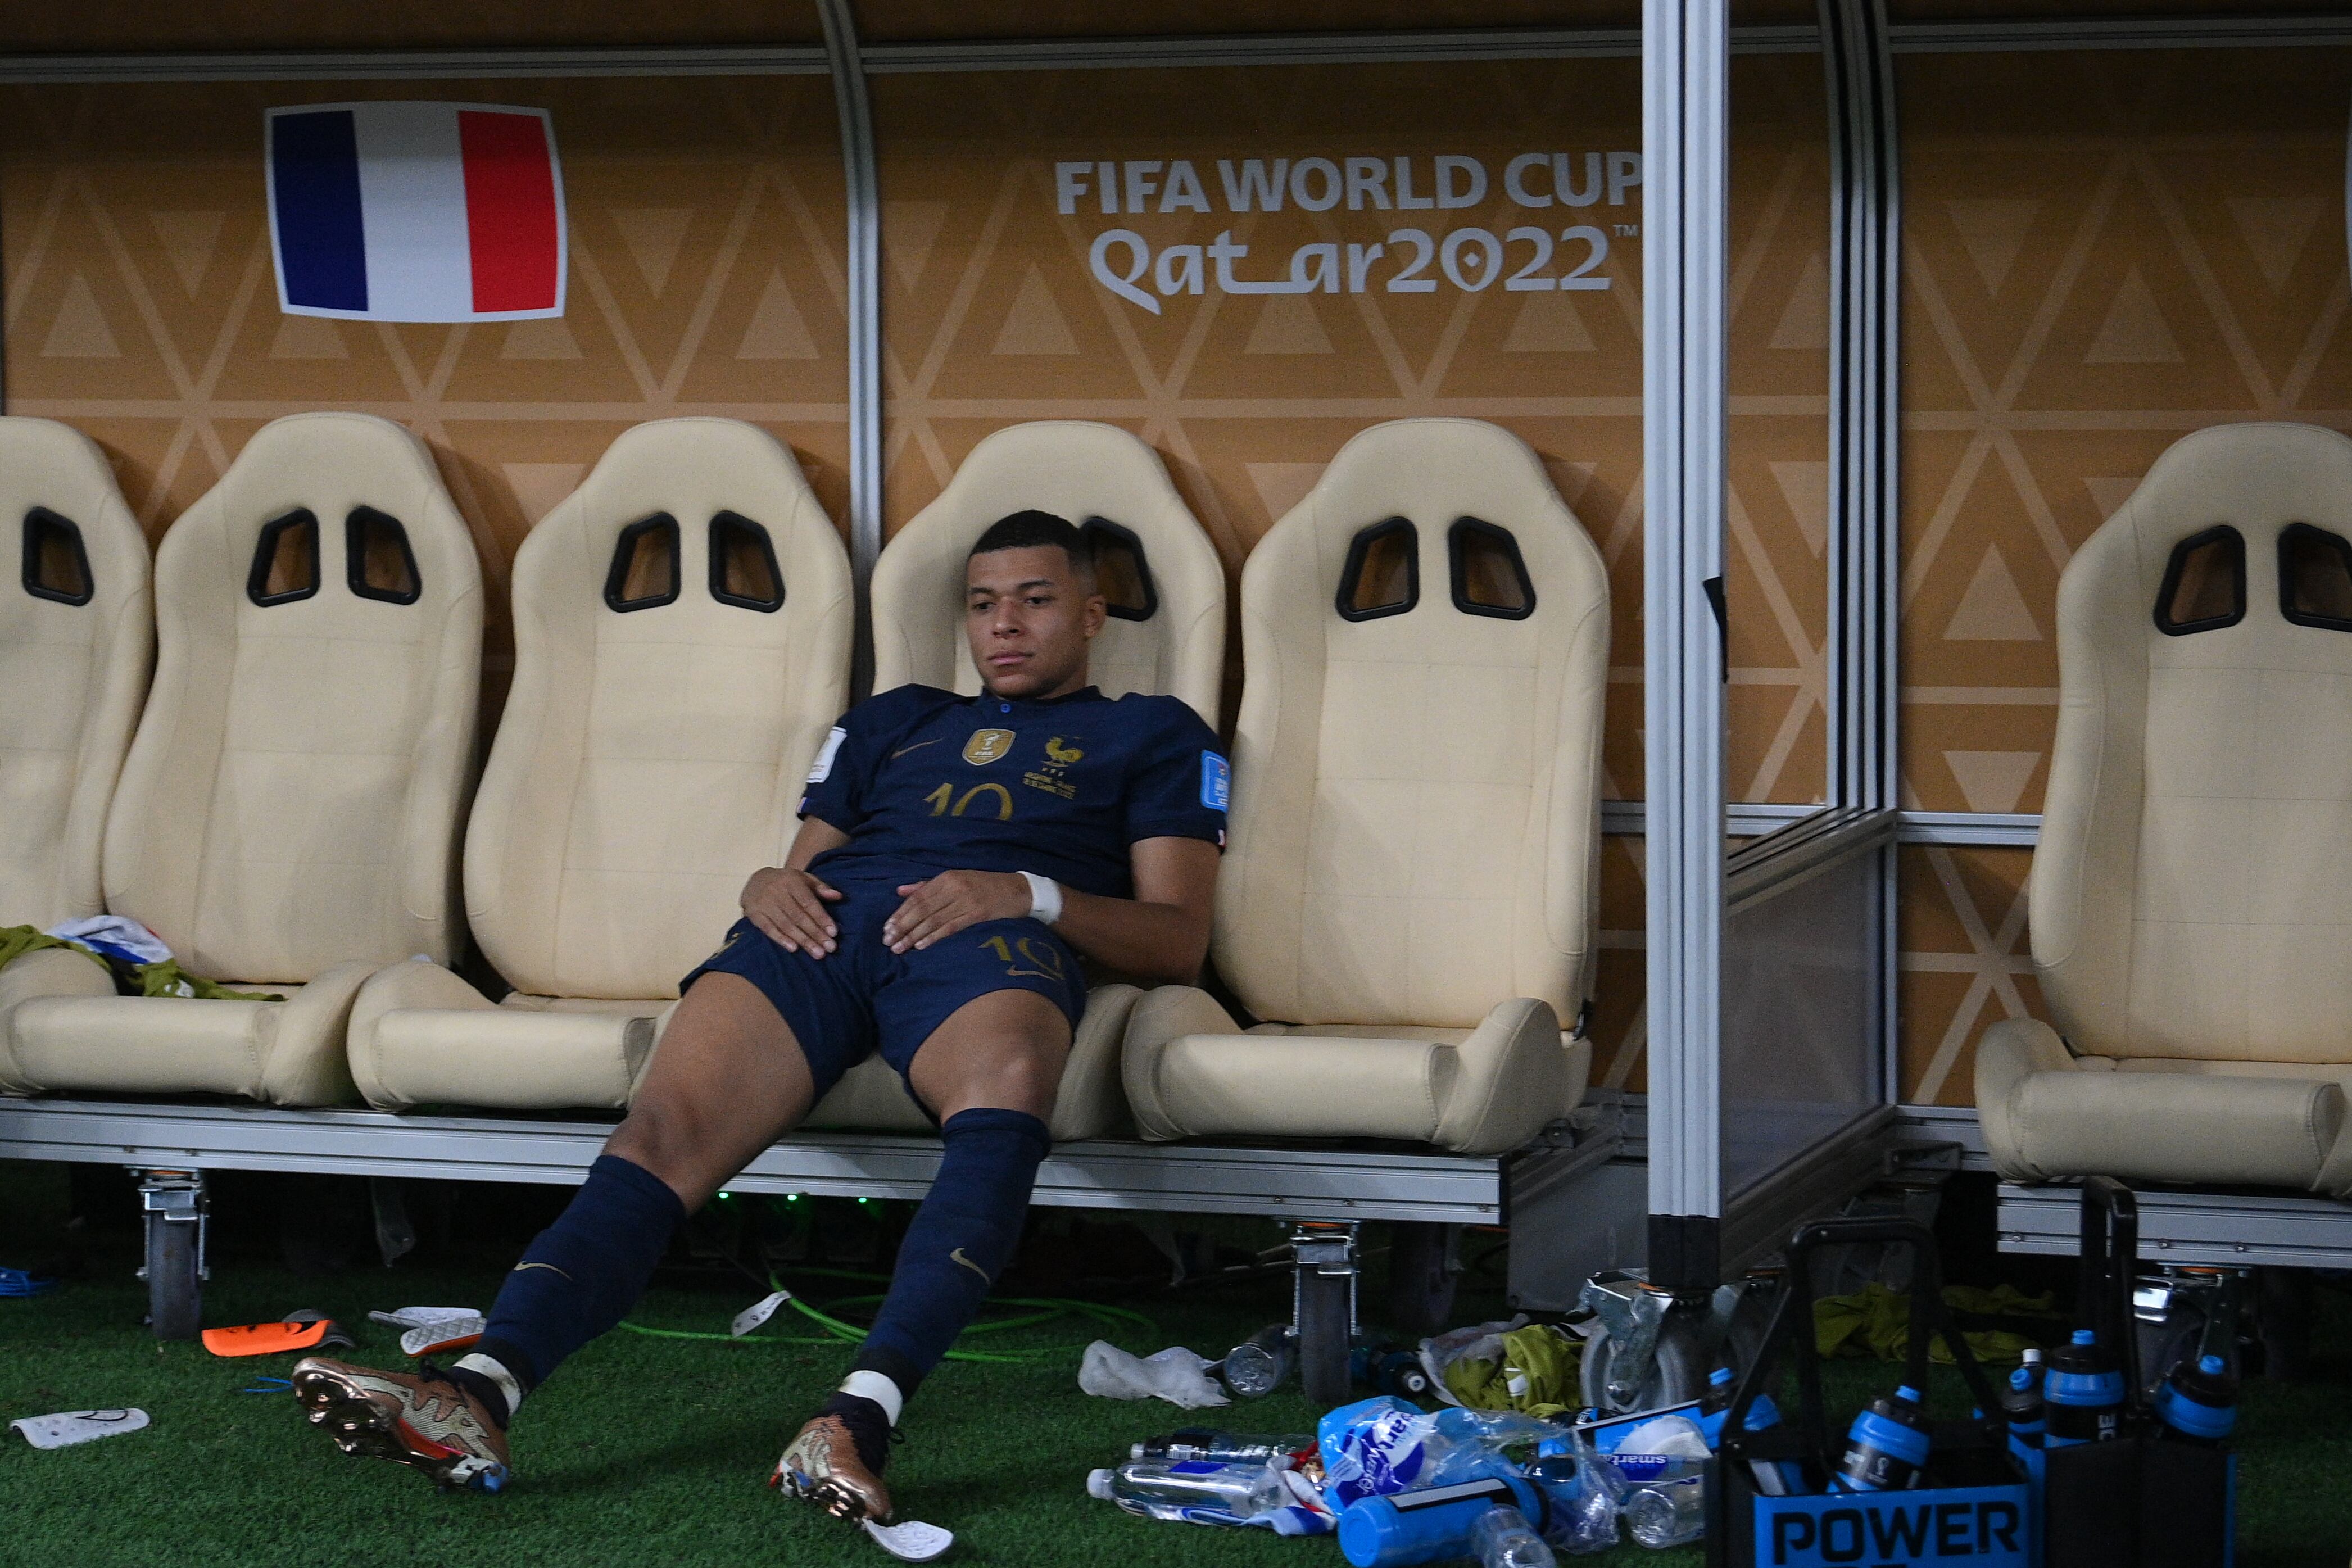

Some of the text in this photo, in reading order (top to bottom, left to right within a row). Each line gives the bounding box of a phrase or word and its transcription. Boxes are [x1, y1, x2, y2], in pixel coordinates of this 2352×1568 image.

[1055, 151, 1643, 215] FIFA WORLD CUP
[922, 782, 1013, 821] 10
[978, 936, 1066, 981] 10
[1604, 1455, 1667, 1466] smart
[1773, 1501, 2020, 1565] POWER
